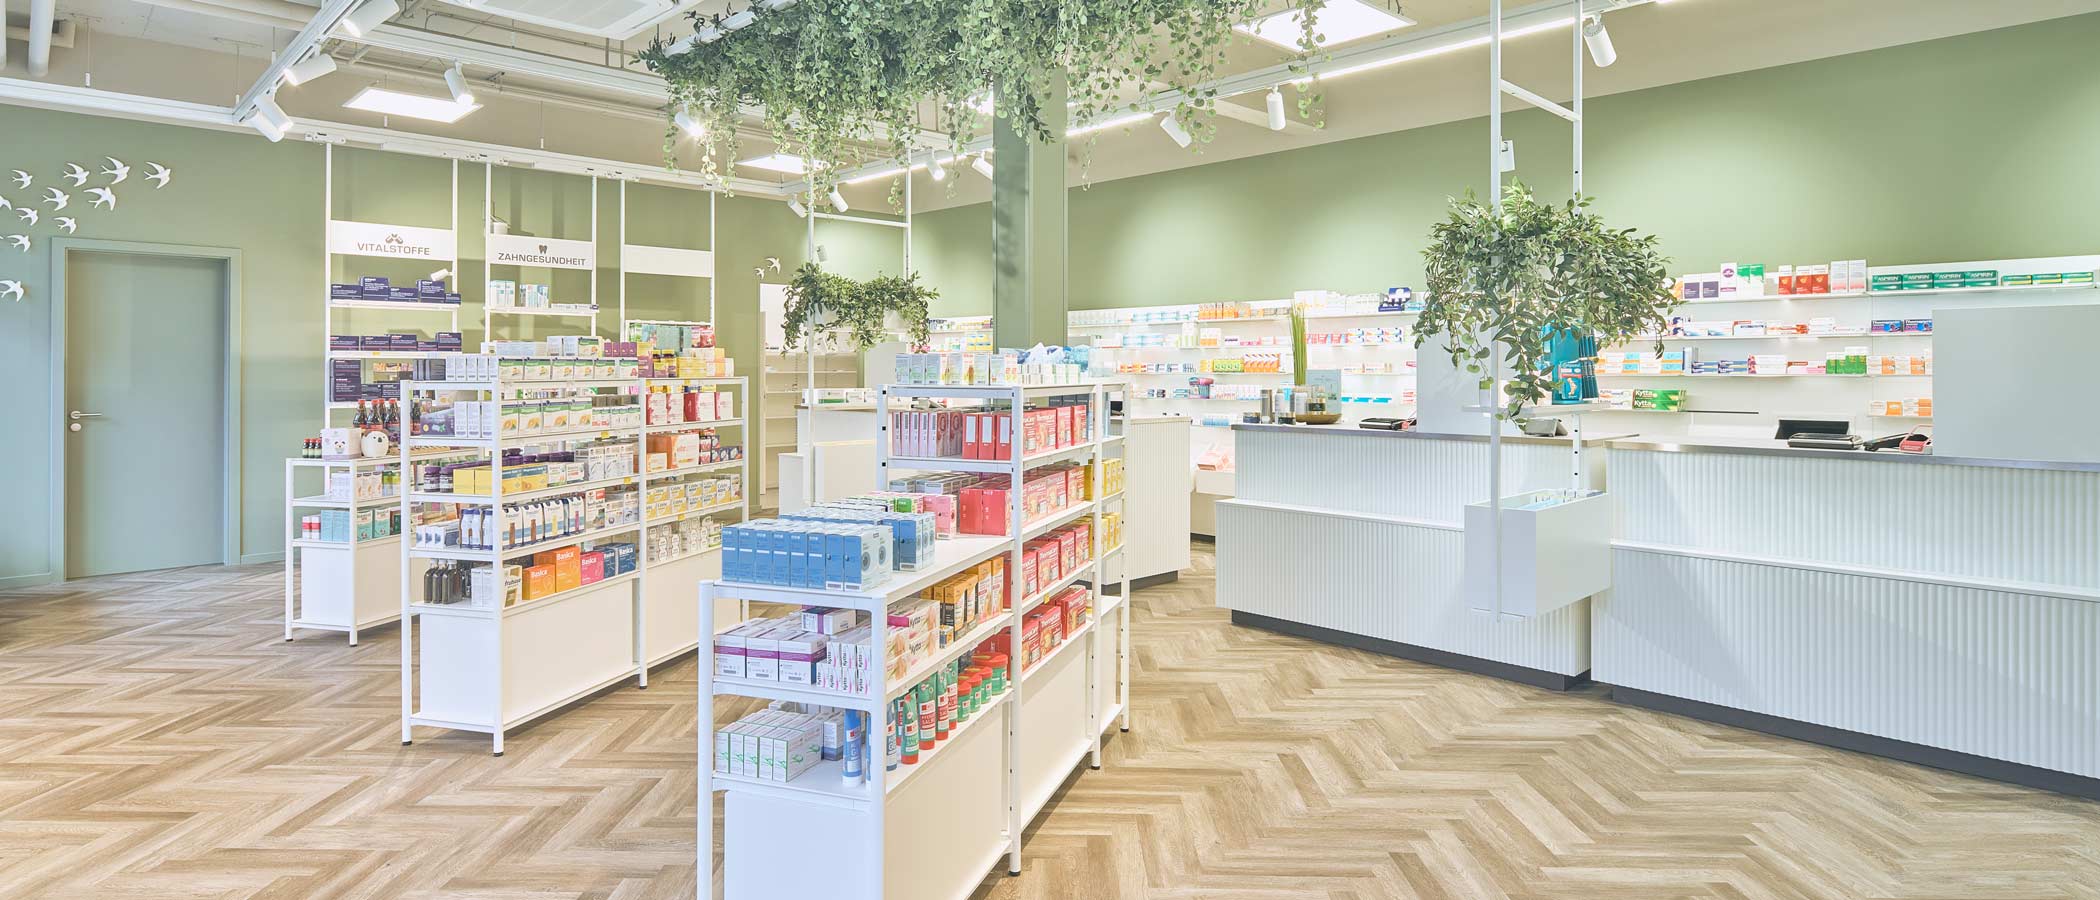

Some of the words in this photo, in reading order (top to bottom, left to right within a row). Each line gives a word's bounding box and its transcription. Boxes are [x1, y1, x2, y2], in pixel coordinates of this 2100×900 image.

[357, 242, 430, 256] VITALSTOFFE
[498, 252, 586, 266] ZAHNGESUNDHEIT
[1635, 400, 1652, 408] Kytta
[556, 551, 575, 561] Basica
[619, 547, 633, 556] Basica
[581, 556, 597, 566] Basica
[531, 568, 548, 578] Basica
